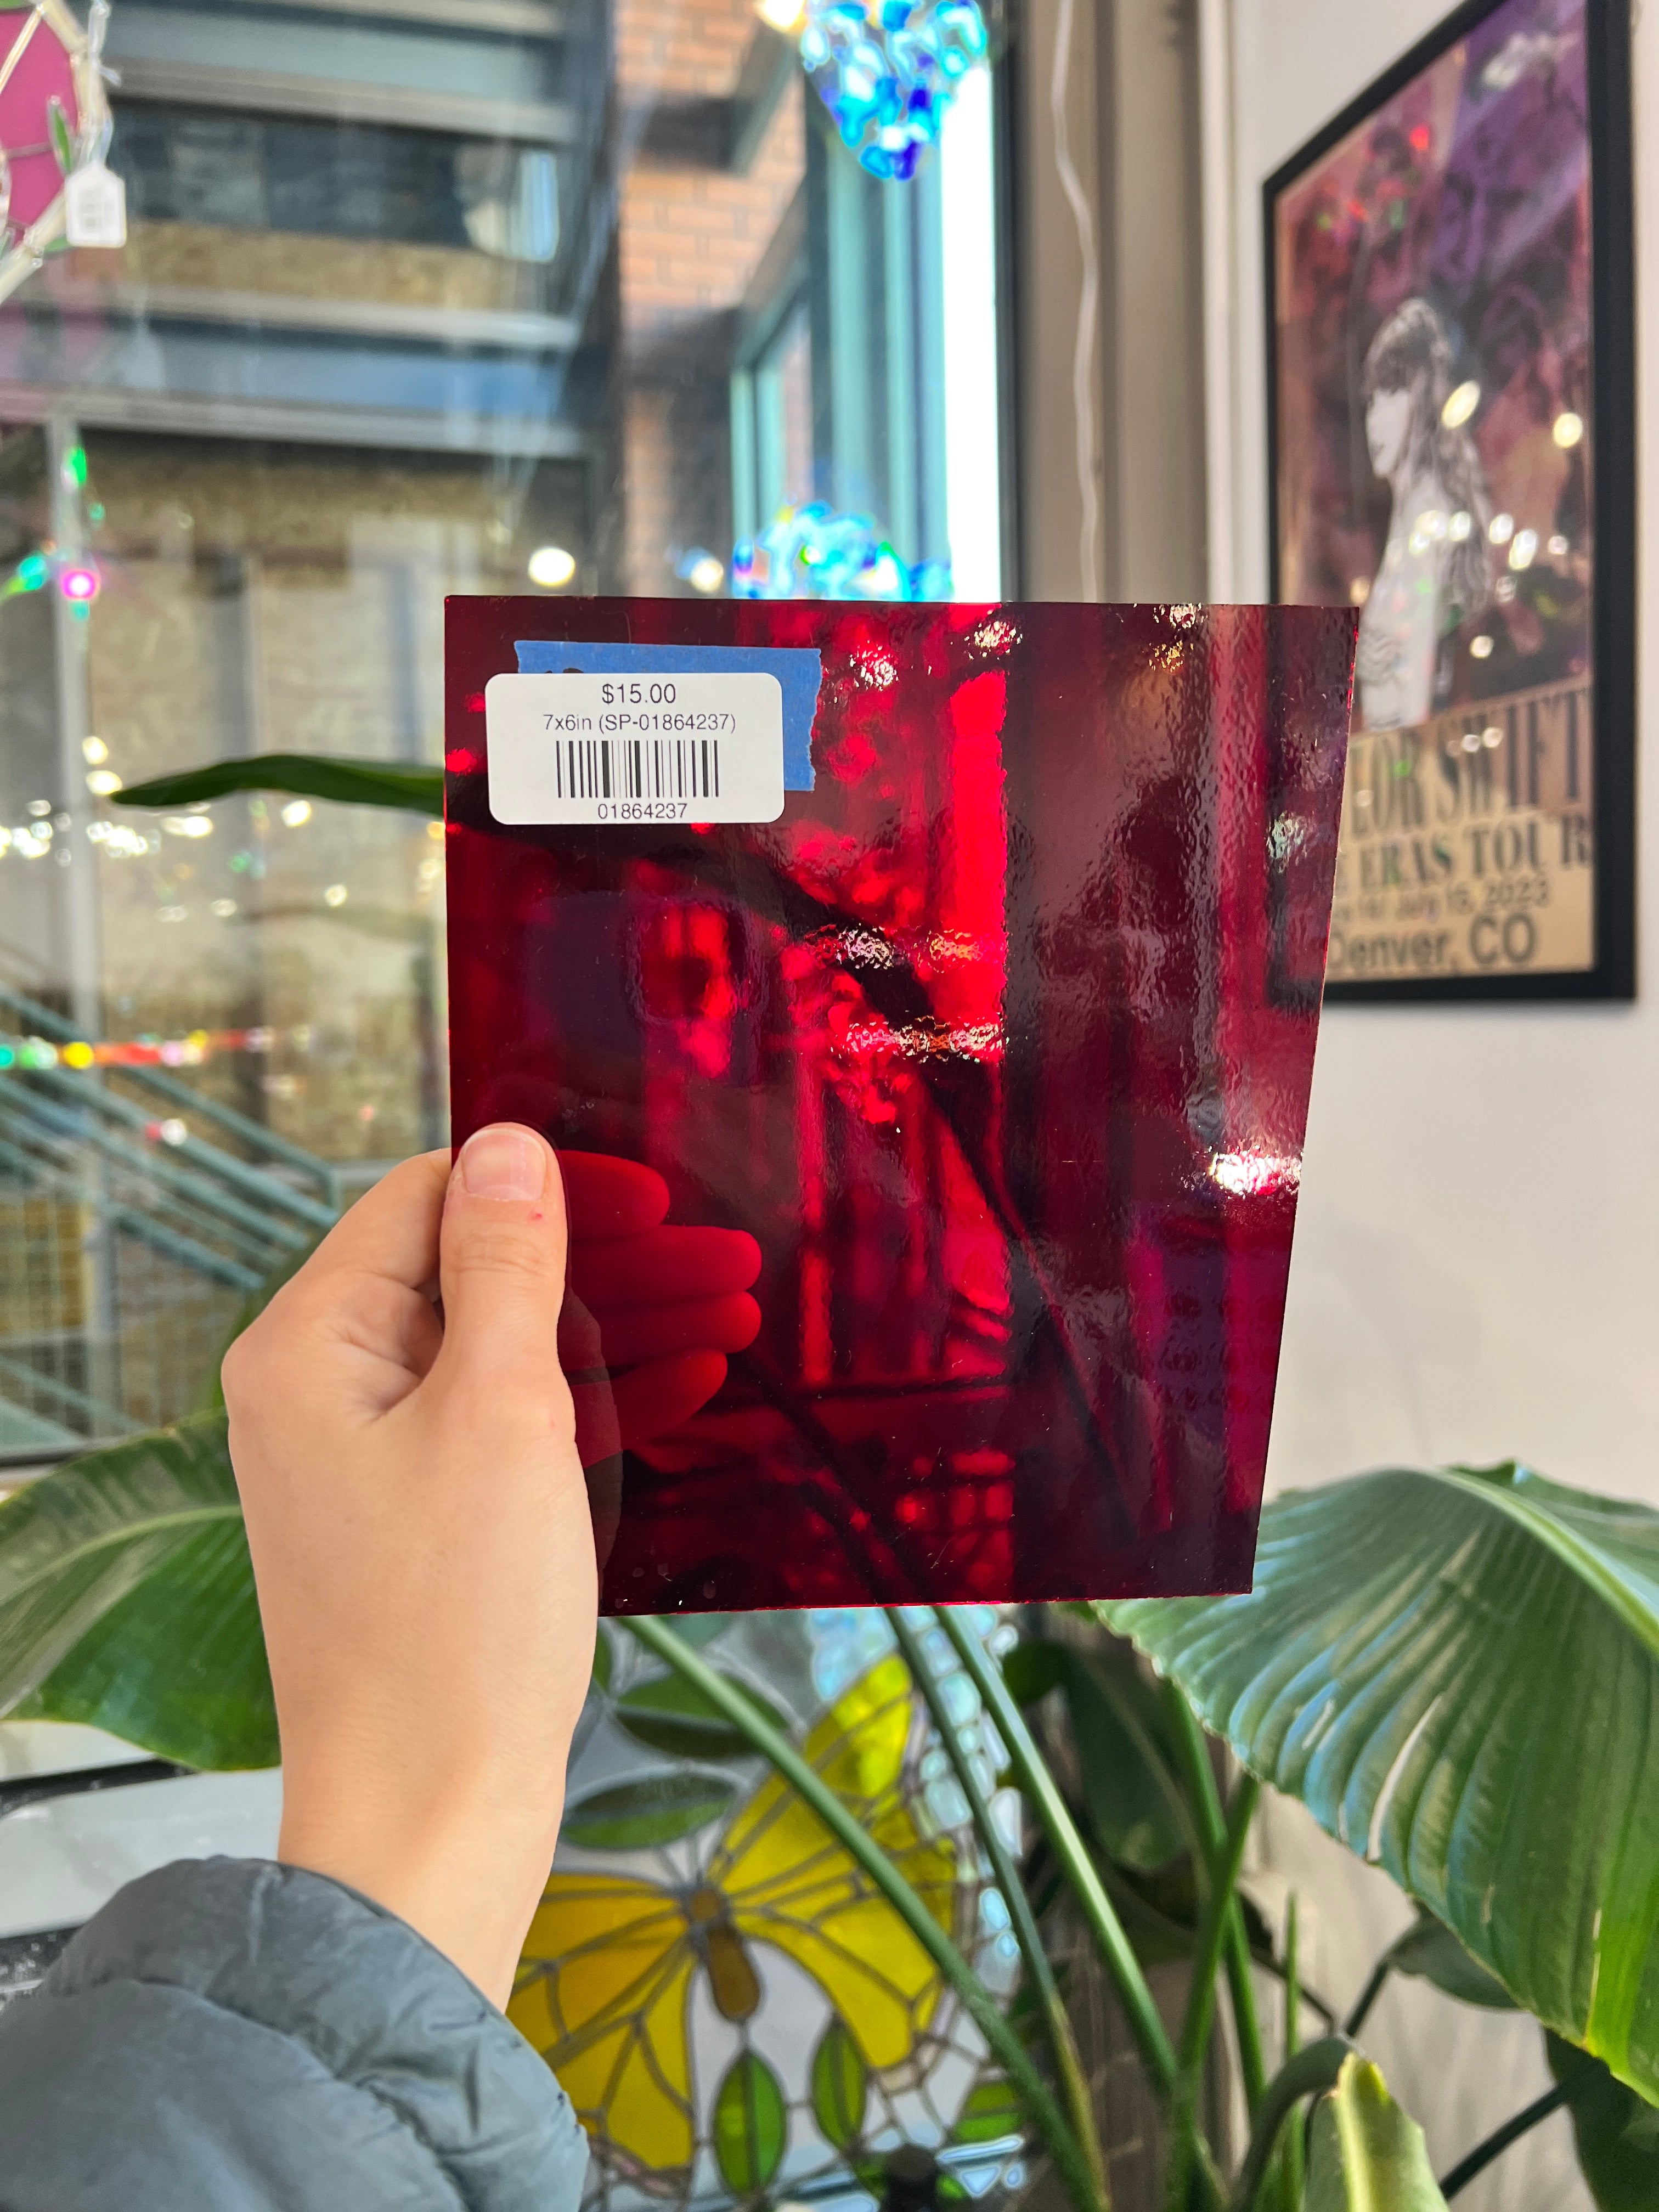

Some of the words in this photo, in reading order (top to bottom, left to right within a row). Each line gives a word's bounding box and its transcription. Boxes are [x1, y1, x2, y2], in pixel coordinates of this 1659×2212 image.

[601, 682, 676, 706] $15.00
[543, 714, 592, 731] 7x6in
[599, 714, 736, 734] (SP-01864237)
[597, 803, 688, 820] 01864237
[1469, 911, 1538, 964] CO
